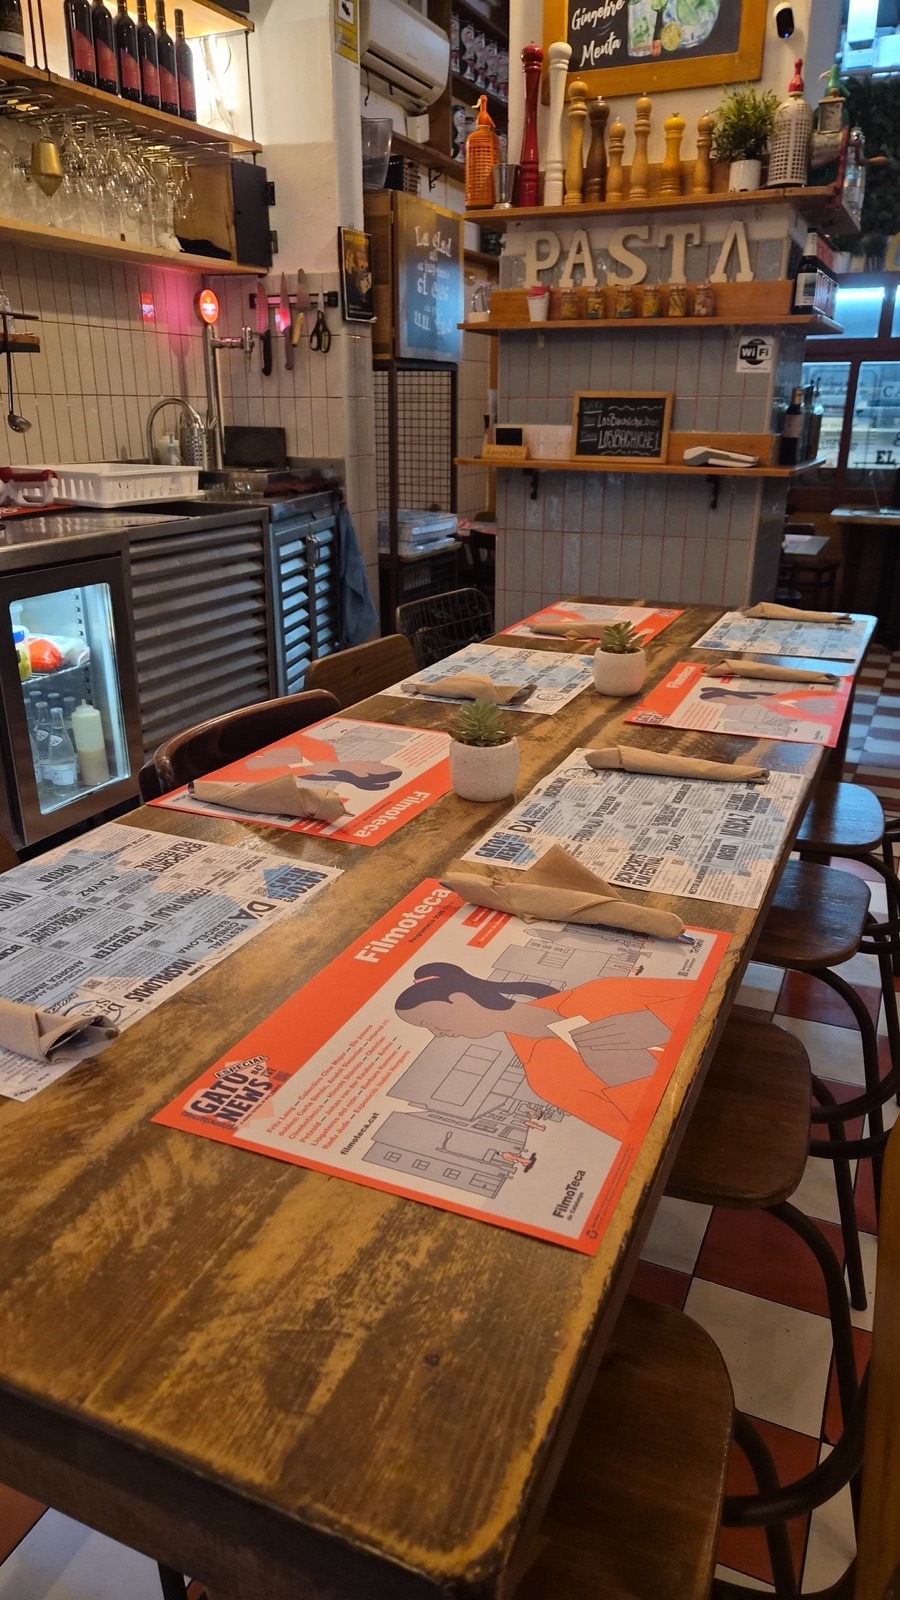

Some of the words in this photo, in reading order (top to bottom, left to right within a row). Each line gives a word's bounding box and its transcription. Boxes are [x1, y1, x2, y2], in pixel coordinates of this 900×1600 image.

[572, 0, 625, 30] Gingebre
[580, 32, 622, 66] Menta
[876, 451, 895, 464] EL
[352, 790, 432, 838] Filmoteca
[132, 849, 177, 870] FESTIVAL
[167, 840, 193, 851] FILM
[473, 838, 508, 857] GATO
[493, 841, 525, 860] NEWS
[147, 852, 190, 873] SPORTS
[620, 853, 648, 872] SPORTS
[638, 855, 664, 876] FESTIVAL
[74, 874, 120, 897] FLAYAZ
[266, 867, 310, 889] NEWS
[283, 870, 330, 894] GATO
[631, 874, 652, 886] FILM
[174, 919, 230, 954] BARCELONA
[203, 922, 240, 943] CINEMA
[206, 924, 249, 950] FESTIVAL
[353, 887, 453, 962] Filmoteca
[89, 930, 143, 960] THEATER
[45, 960, 85, 982] ANDREA
[121, 958, 196, 1002] MASPALOMAS
[218, 1056, 267, 1077] ESPECIAL
[276, 1116, 299, 1136] dobles:
[295, 1101, 313, 1116] Carla
[309, 1083, 330, 1101] Simón,
[326, 1067, 345, 1083] Anahit
[341, 1046, 365, 1067] Simonian
[365, 1024, 385, 1041] Interval
[191, 1073, 249, 1113] GATO
[251, 1065, 264, 1075] #47
[216, 1079, 273, 1123] NEWS
[265, 1120, 282, 1133] Fritz
[278, 1106, 296, 1120] Lang
[297, 1076, 324, 1100] Colectivo
[320, 1065, 335, 1076] Cine
[330, 1051, 348, 1065] Mujer
[287, 1104, 324, 1139] Cinebotànica
[326, 1080, 346, 1098] Hiroshi
[343, 1061, 364, 1079] Shimizu
[364, 1035, 387, 1056] Christian
[298, 1121, 322, 1142] Petzold
[323, 1098, 342, 1115] Johan
[338, 1089, 351, 1098] van
[347, 1079, 359, 1088] der
[355, 1061, 376, 1079] Keuken
[377, 1041, 393, 1056] Anime
[310, 1116, 341, 1146] Llogateres
[336, 1107, 348, 1116] del
[344, 1095, 359, 1107] món
[360, 1070, 381, 1089] Barbara
[377, 1050, 398, 1069] Hammer
[321, 1134, 339, 1149] Radu
[334, 1119, 351, 1134] Jude
[353, 1087, 380, 1113] Exposició:
[375, 1071, 393, 1086] Isabel
[339, 1111, 380, 1155] filmoteca.cat
[551, 1168, 586, 1218] FilmoTeca
[569, 1191, 585, 1213] Catalunya
